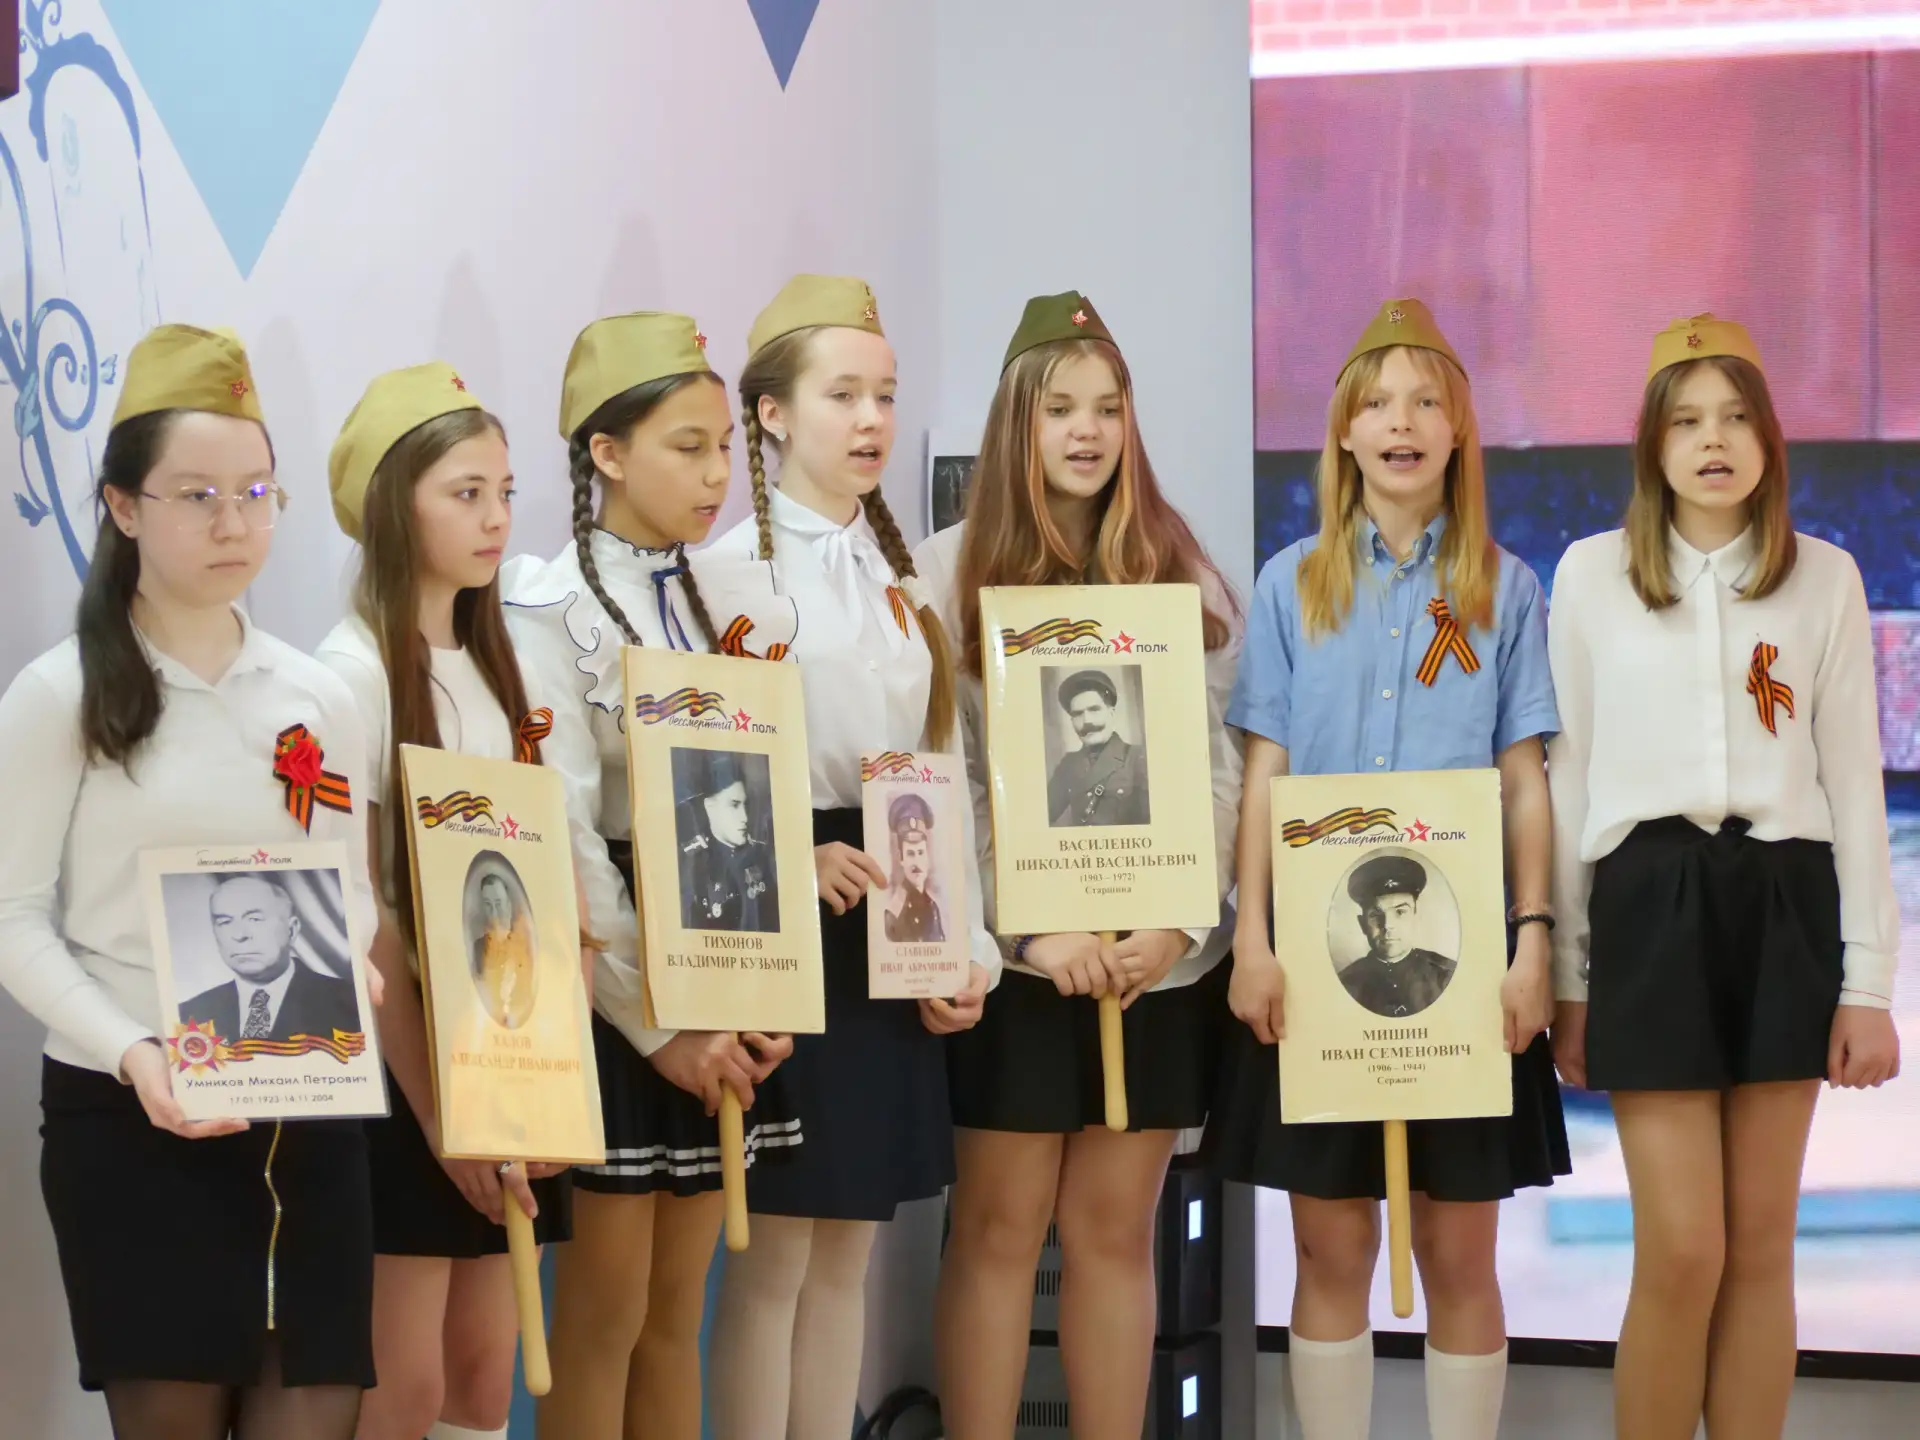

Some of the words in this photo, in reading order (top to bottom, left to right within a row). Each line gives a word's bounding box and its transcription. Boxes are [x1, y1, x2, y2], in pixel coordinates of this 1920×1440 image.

[1059, 837, 1152, 851] ВАСИЛЕНКО
[1016, 855, 1091, 871] НИКОЛАЙ
[1096, 854, 1197, 869] ВАСИЛЬЕВИЧ
[1085, 886, 1132, 895] Старшина
[702, 935, 763, 950] ТИХОНОВ
[667, 954, 736, 970] ВЛАДИМИР
[740, 956, 798, 971] КУЗЬМИЧ
[1362, 1027, 1428, 1041] МИШИН
[1321, 1048, 1364, 1061] ИВАН
[1369, 1044, 1471, 1059] СЕМЕНОВИЧ
[186, 1078, 244, 1088] Умников
[248, 1075, 300, 1086] Михаил
[303, 1074, 367, 1086] Петрович
[1377, 1075, 1417, 1086] Сержант
